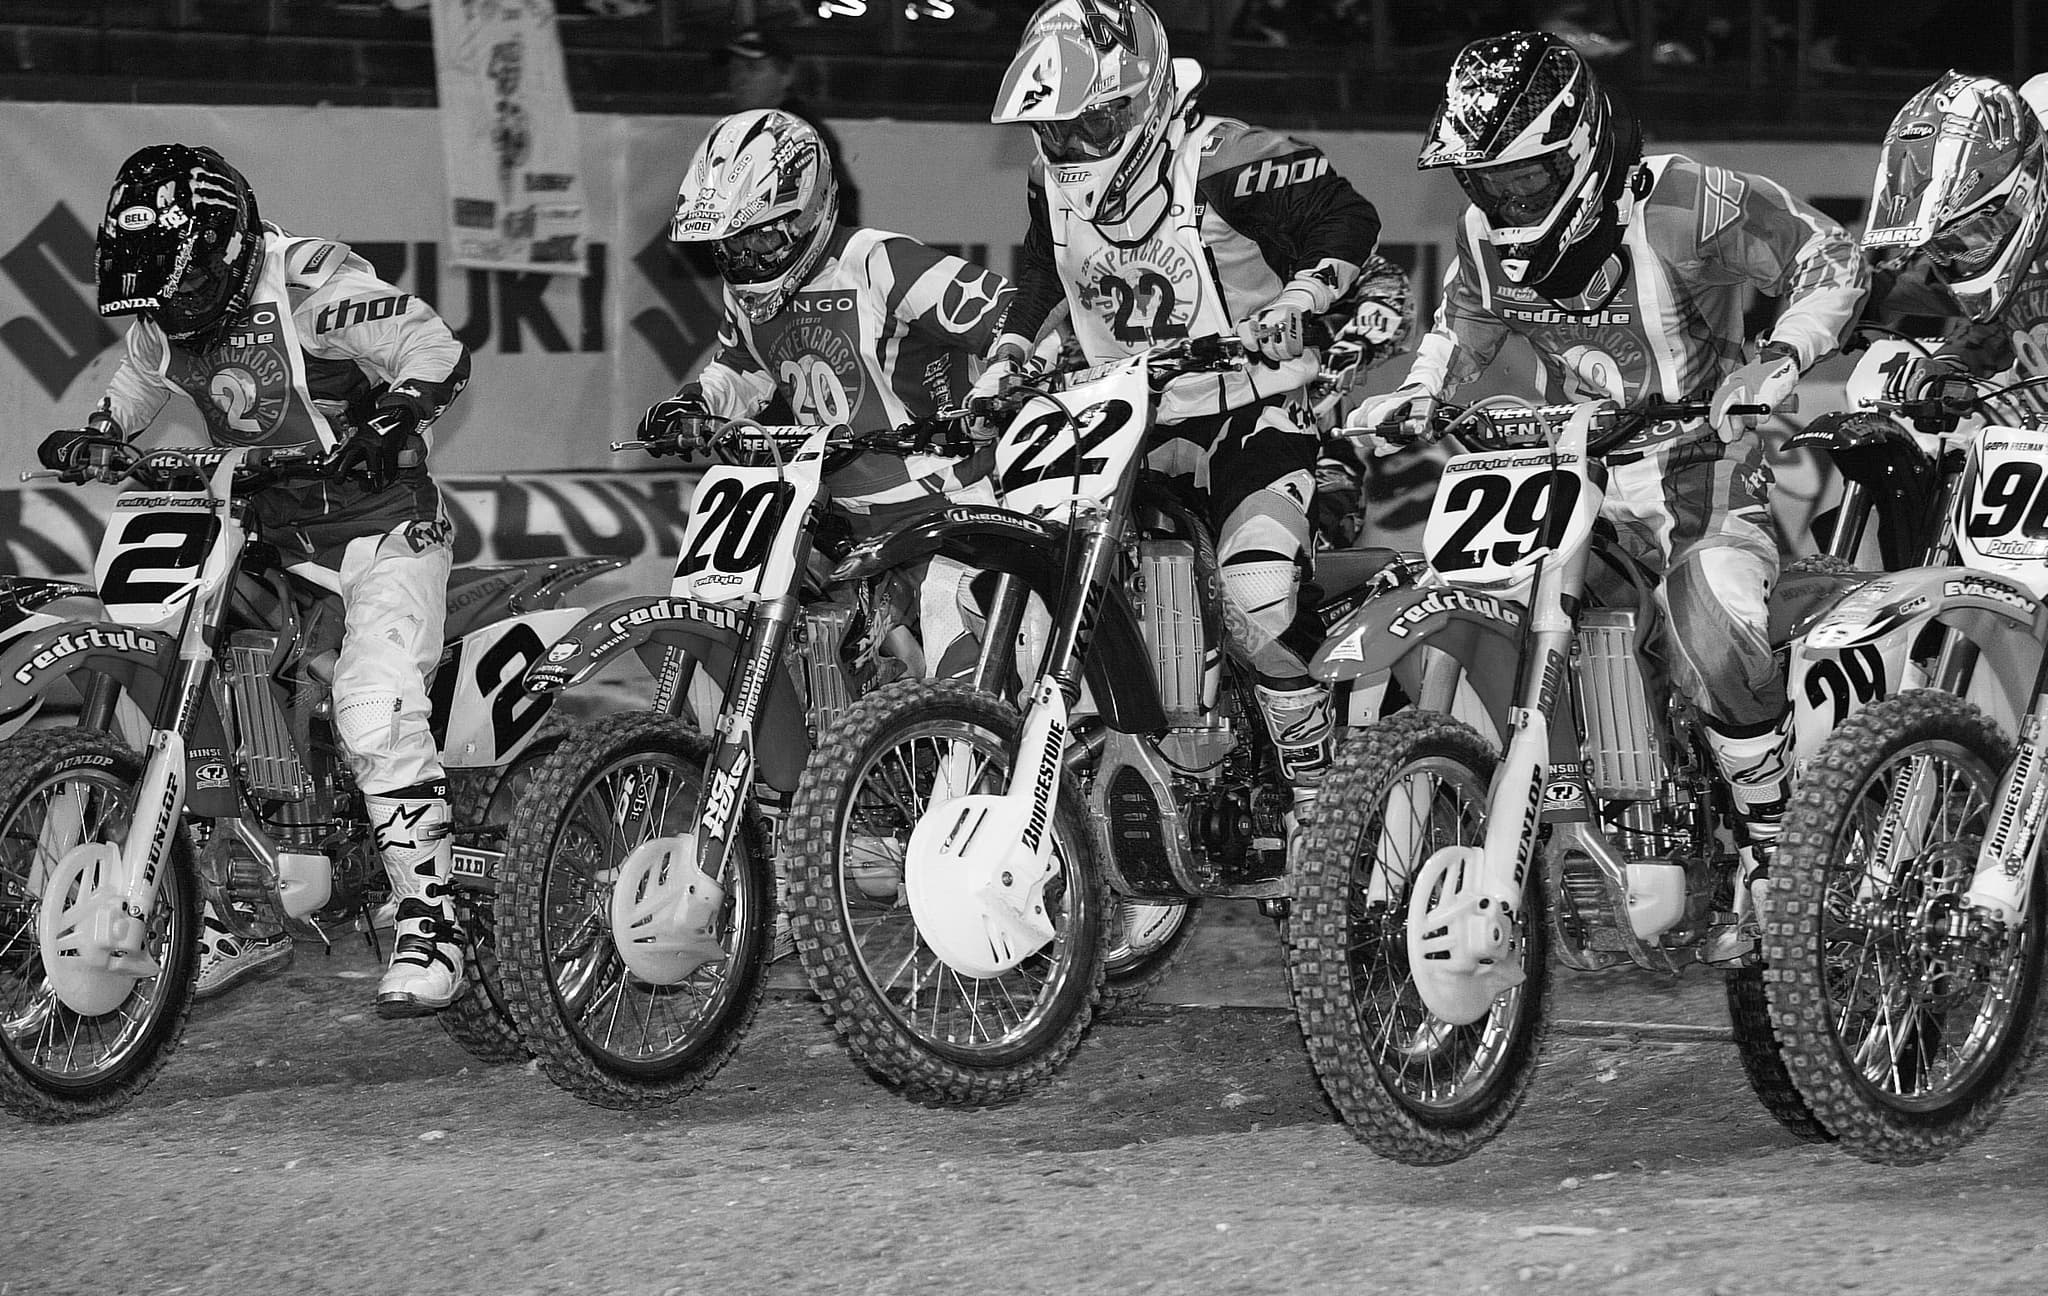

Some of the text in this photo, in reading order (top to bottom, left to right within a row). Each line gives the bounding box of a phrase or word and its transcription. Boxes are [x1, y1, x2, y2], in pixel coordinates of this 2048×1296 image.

[1433, 151, 1484, 163] HONDA
[124, 212, 149, 224] BELL
[683, 221, 712, 233] SHOEI
[1863, 228, 1921, 246] SHARK
[101, 298, 160, 314] HONDA
[792, 298, 854, 314] NGO
[1100, 273, 1190, 342] 22
[211, 372, 262, 432] 2
[780, 360, 851, 426] 20
[1001, 399, 1132, 494] 22
[1792, 431, 1833, 443] YAMAHA
[1446, 453, 1578, 473] redstyle redsyle
[116, 497, 166, 508] redstyle
[1431, 469, 1582, 573] 29
[673, 477, 796, 579] 20
[99, 512, 222, 605] 2
[694, 574, 744, 589] redstyle
[1388, 589, 1521, 639] redstyle
[1944, 580, 2037, 614] EVASION
[14, 627, 158, 686] redstyle
[589, 631, 631, 657] SAMSUNG
[475, 622, 554, 761] 2
[54, 755, 114, 774] DUNLOP
[1021, 718, 1067, 855] BRIDGESTONE
[1513, 763, 1542, 889] DUNLOP
[1986, 744, 2036, 860] BRIDGESTONE
[143, 771, 178, 887] DUNLOP
